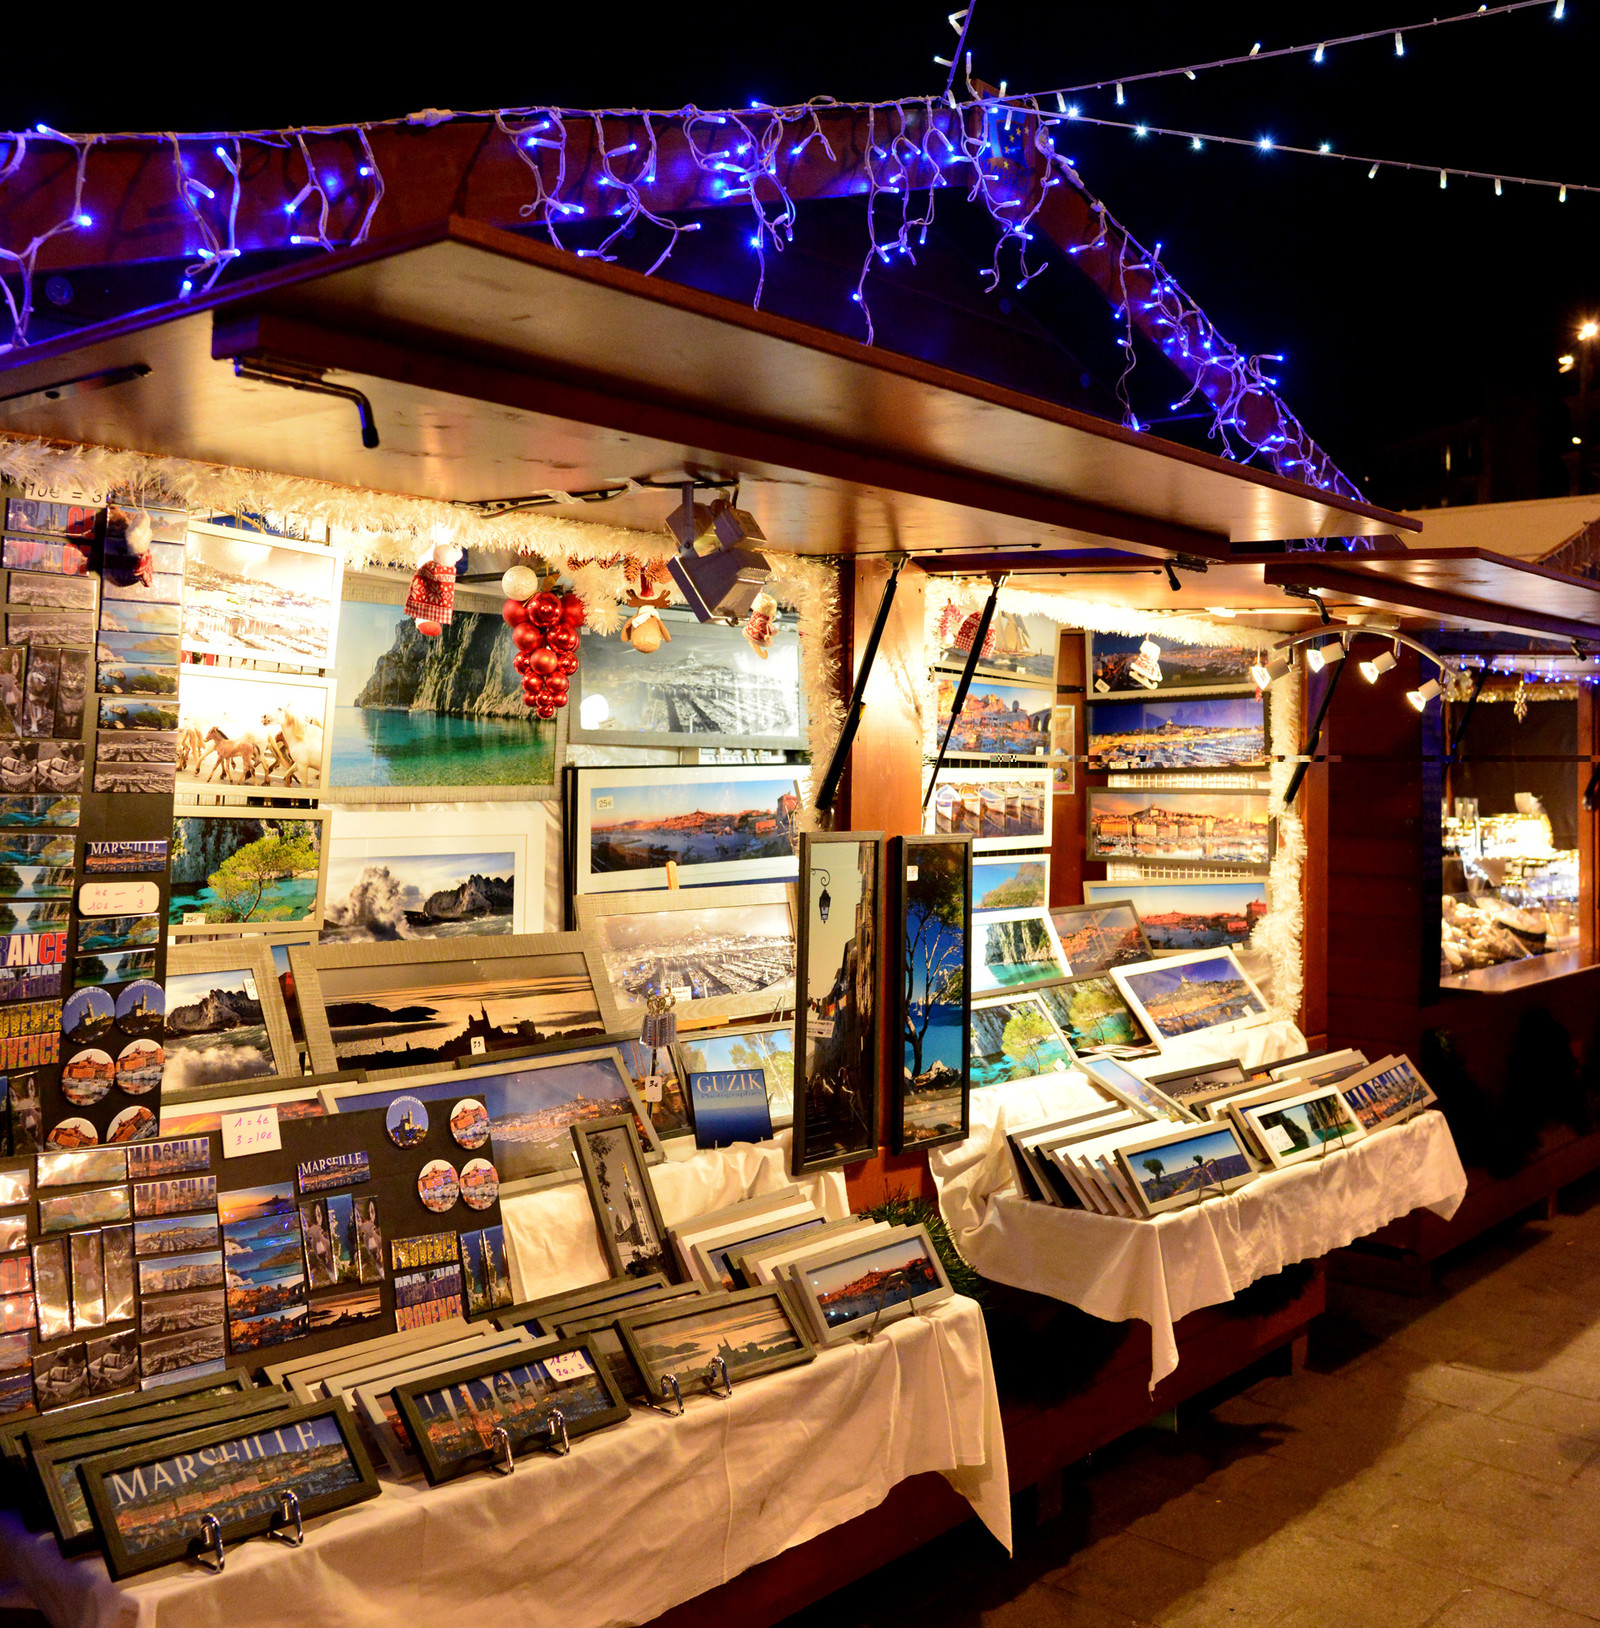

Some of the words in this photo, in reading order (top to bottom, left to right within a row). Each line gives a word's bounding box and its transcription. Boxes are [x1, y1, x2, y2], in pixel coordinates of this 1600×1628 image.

[90, 842, 160, 856] MARSEILLE
[696, 1073, 763, 1094] GUZIK
[302, 1151, 363, 1176] MARSEILLE
[112, 1420, 321, 1507] MARSEILLE
